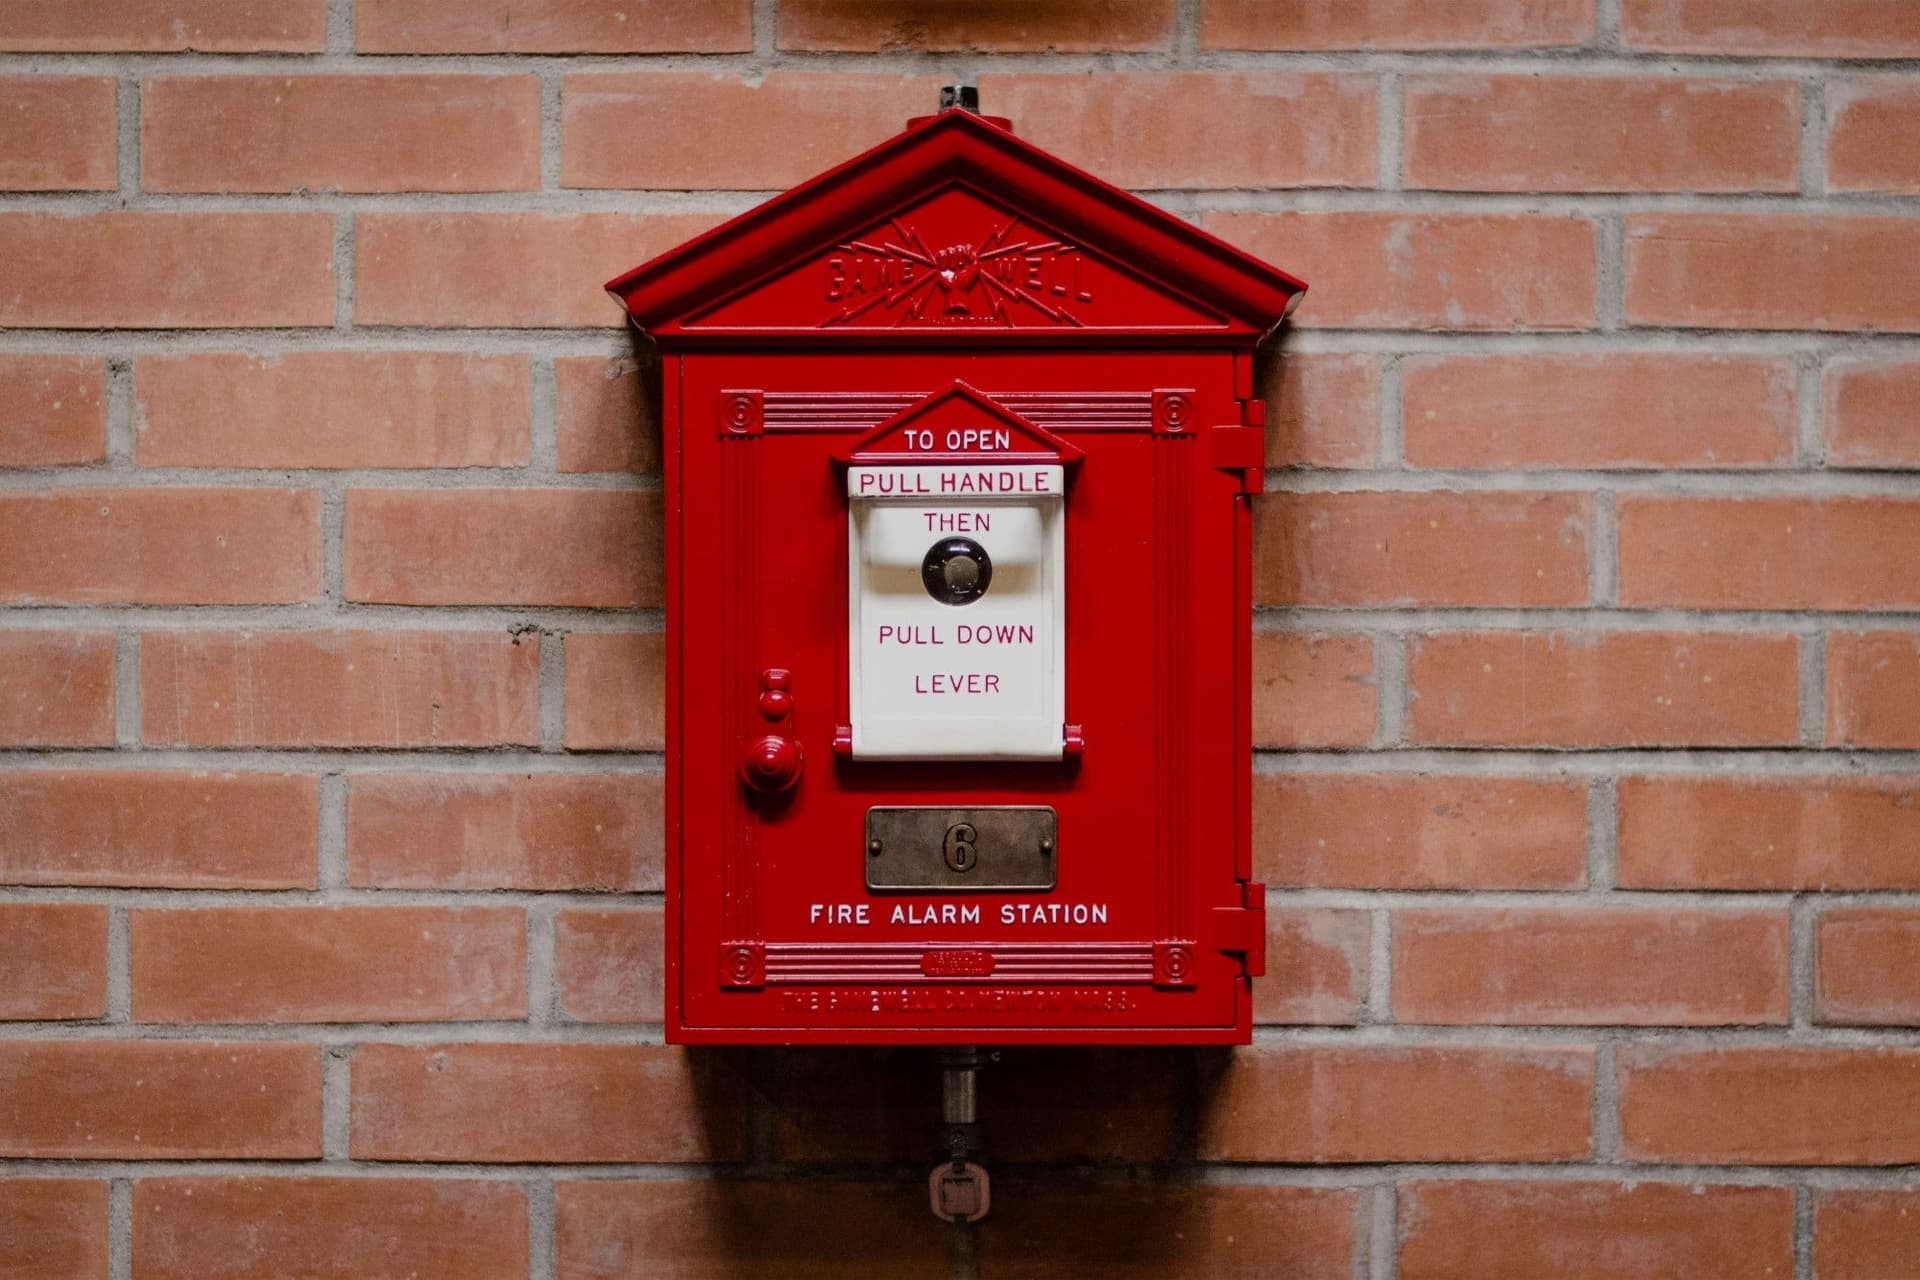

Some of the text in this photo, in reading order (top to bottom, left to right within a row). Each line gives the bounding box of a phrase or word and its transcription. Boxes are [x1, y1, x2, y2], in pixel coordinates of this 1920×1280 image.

[904, 429, 1011, 450] TO OPEN
[860, 471, 1050, 493] PULL HANDLE
[923, 512, 991, 532] THEN
[879, 624, 1034, 645] PULL DOWN
[915, 674, 1000, 693] LEVER
[942, 822, 978, 874] 6
[810, 903, 1108, 926] FIRE ALARM STATION
